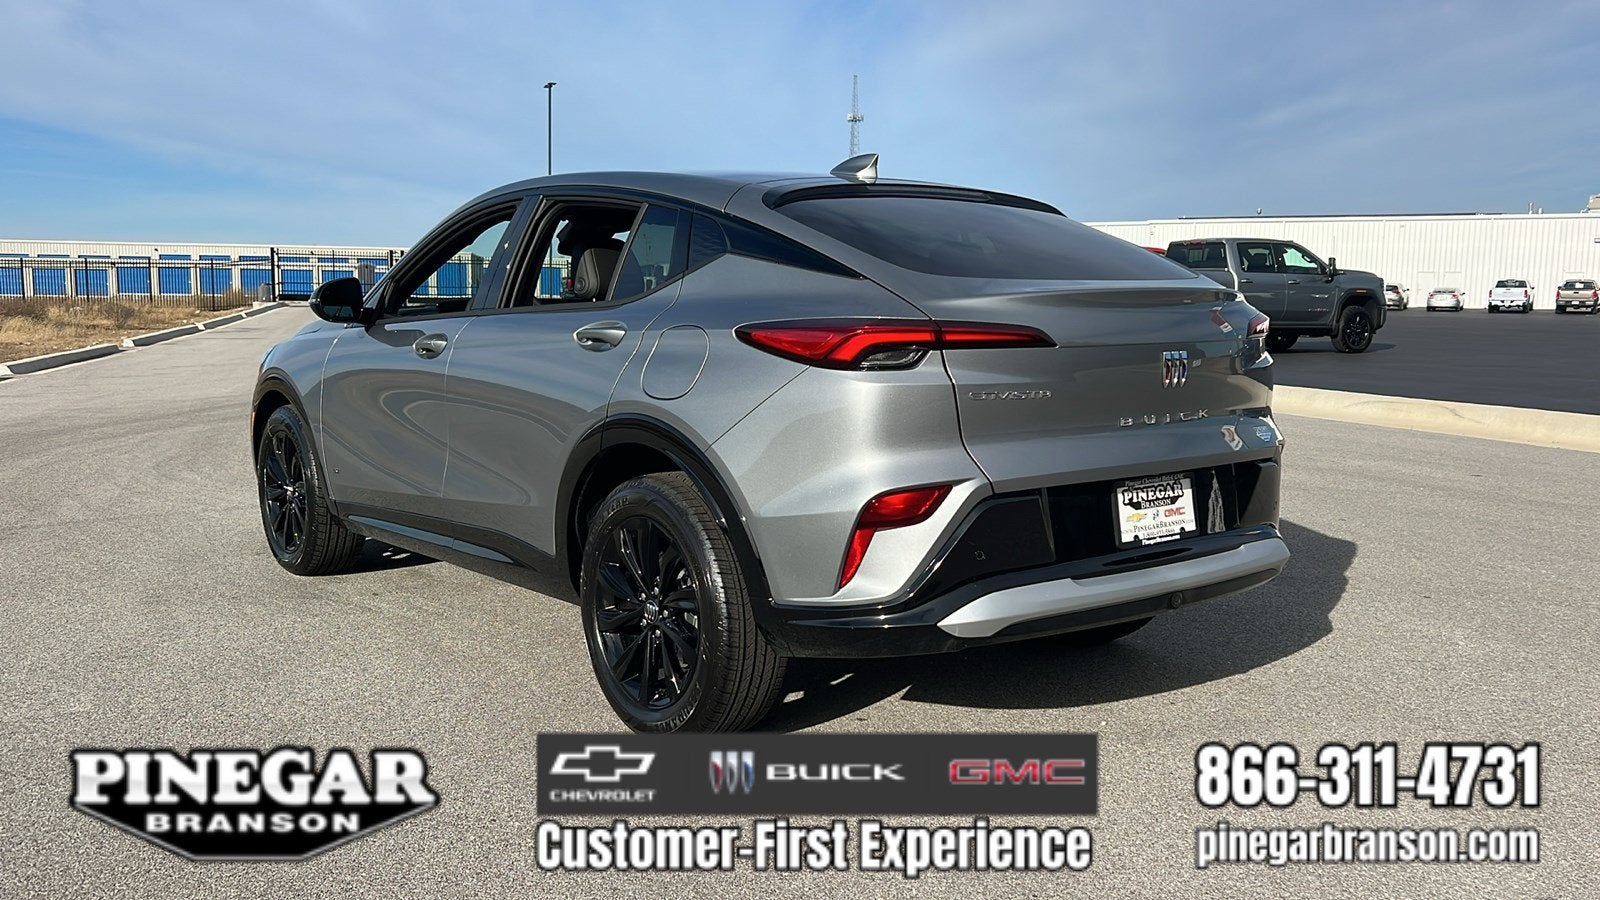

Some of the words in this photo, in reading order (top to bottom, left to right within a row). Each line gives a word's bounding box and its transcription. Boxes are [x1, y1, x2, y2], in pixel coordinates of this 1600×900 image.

[1120, 409, 1208, 426] BUICK
[1123, 483, 1184, 504] PINEGAR
[1141, 498, 1171, 509] BRANSON
[1164, 507, 1185, 517] GMC
